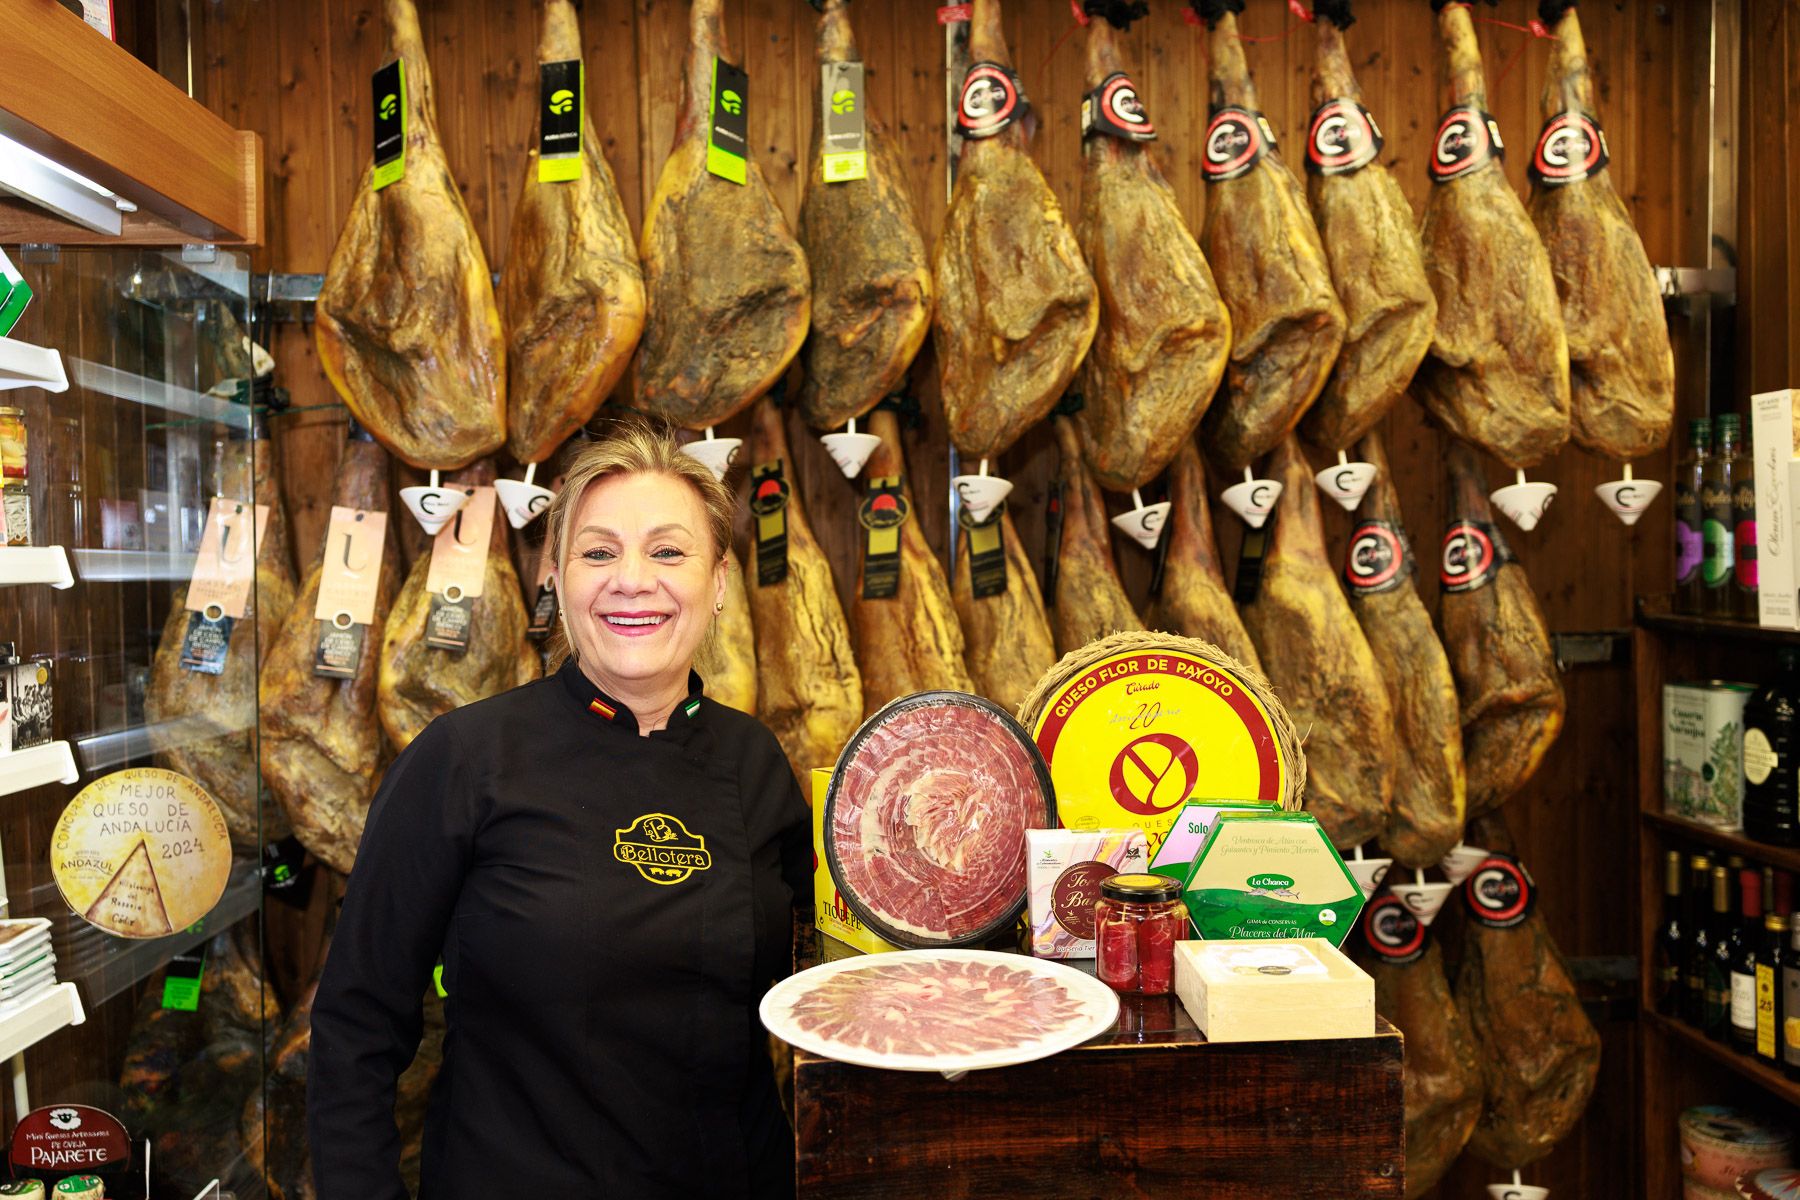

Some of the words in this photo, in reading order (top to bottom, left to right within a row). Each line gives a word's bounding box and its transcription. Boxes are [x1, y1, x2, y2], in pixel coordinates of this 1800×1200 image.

[1055, 676, 1097, 718] QUESO
[1098, 660, 1139, 683] FLOR
[1147, 658, 1168, 671] DE
[1176, 661, 1233, 698] PAYOYO
[1129, 701, 1161, 730] 20
[120, 784, 176, 799] MEJOR
[57, 792, 90, 850] CONCURSO
[95, 777, 115, 791] DEL
[124, 769, 158, 780] QUESO
[166, 773, 179, 782] DE
[93, 802, 149, 818] QUESO
[168, 802, 189, 817] DE
[99, 816, 192, 837] ANDALUCÍA
[1188, 821, 1209, 834] Solo
[162, 838, 204, 860] 2024
[621, 844, 706, 867] Bellotera
[60, 858, 114, 872] ANDAZUL
[1262, 878, 1290, 886] Chanca
[1228, 926, 1271, 938] Placeres
[1273, 928, 1288, 938] del
[1288, 927, 1316, 939] Mar
[62, 1140, 87, 1149] OVEJA
[31, 1146, 108, 1167] PAJARETE
